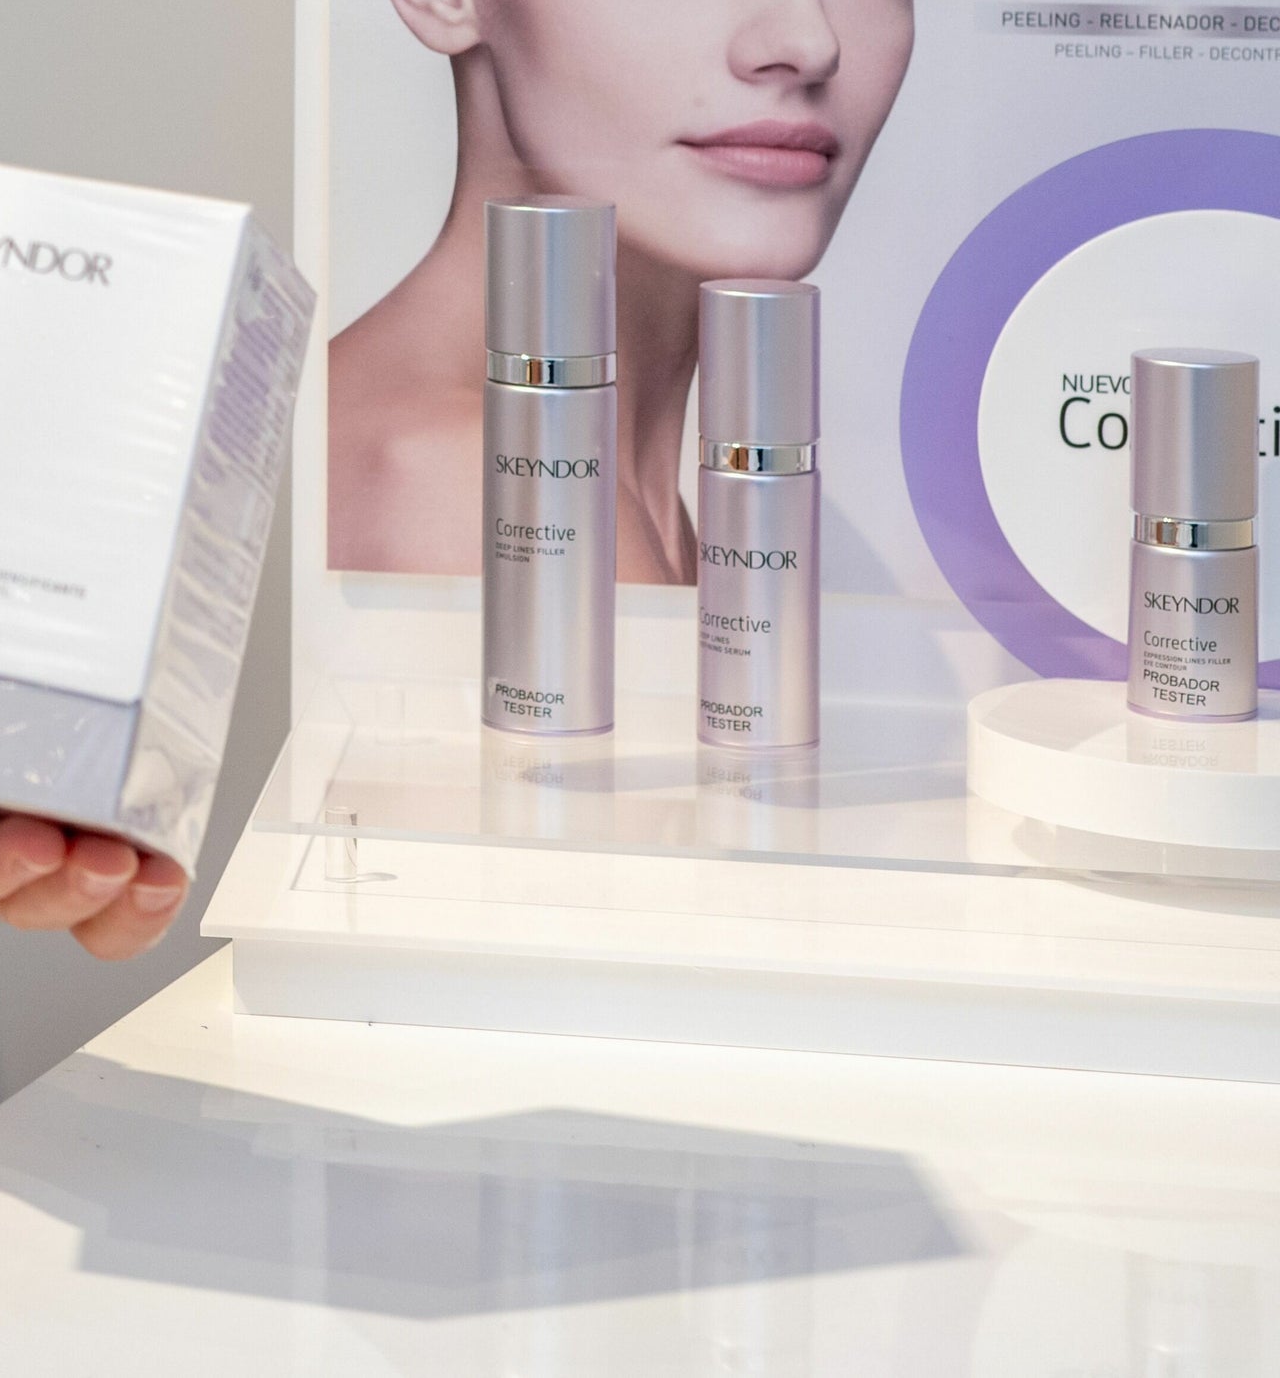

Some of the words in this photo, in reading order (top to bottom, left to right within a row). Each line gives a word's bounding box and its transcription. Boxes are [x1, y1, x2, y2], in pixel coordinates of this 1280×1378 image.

[1001, 11, 1081, 29] PEELING
[1099, 13, 1224, 31] RELLENADOR
[1243, 16, 1280, 32] DEC
[1054, 43, 1122, 59] PEELING
[1139, 45, 1193, 61] FILLER
[496, 454, 600, 479] SKEYNDOR
[496, 517, 576, 541] Corrective
[513, 545, 536, 555] LINES
[537, 548, 566, 556] FILLER
[1144, 591, 1240, 615] SKEYNDOR
[1144, 630, 1217, 652] Corrective
[1143, 669, 1220, 692] PROBADOR
[495, 683, 565, 705] PROBADOR
[1152, 686, 1206, 707] TESTER
[503, 700, 553, 719] TESTER
[700, 698, 763, 718] PROBADOR
[705, 715, 752, 732] TESTER
